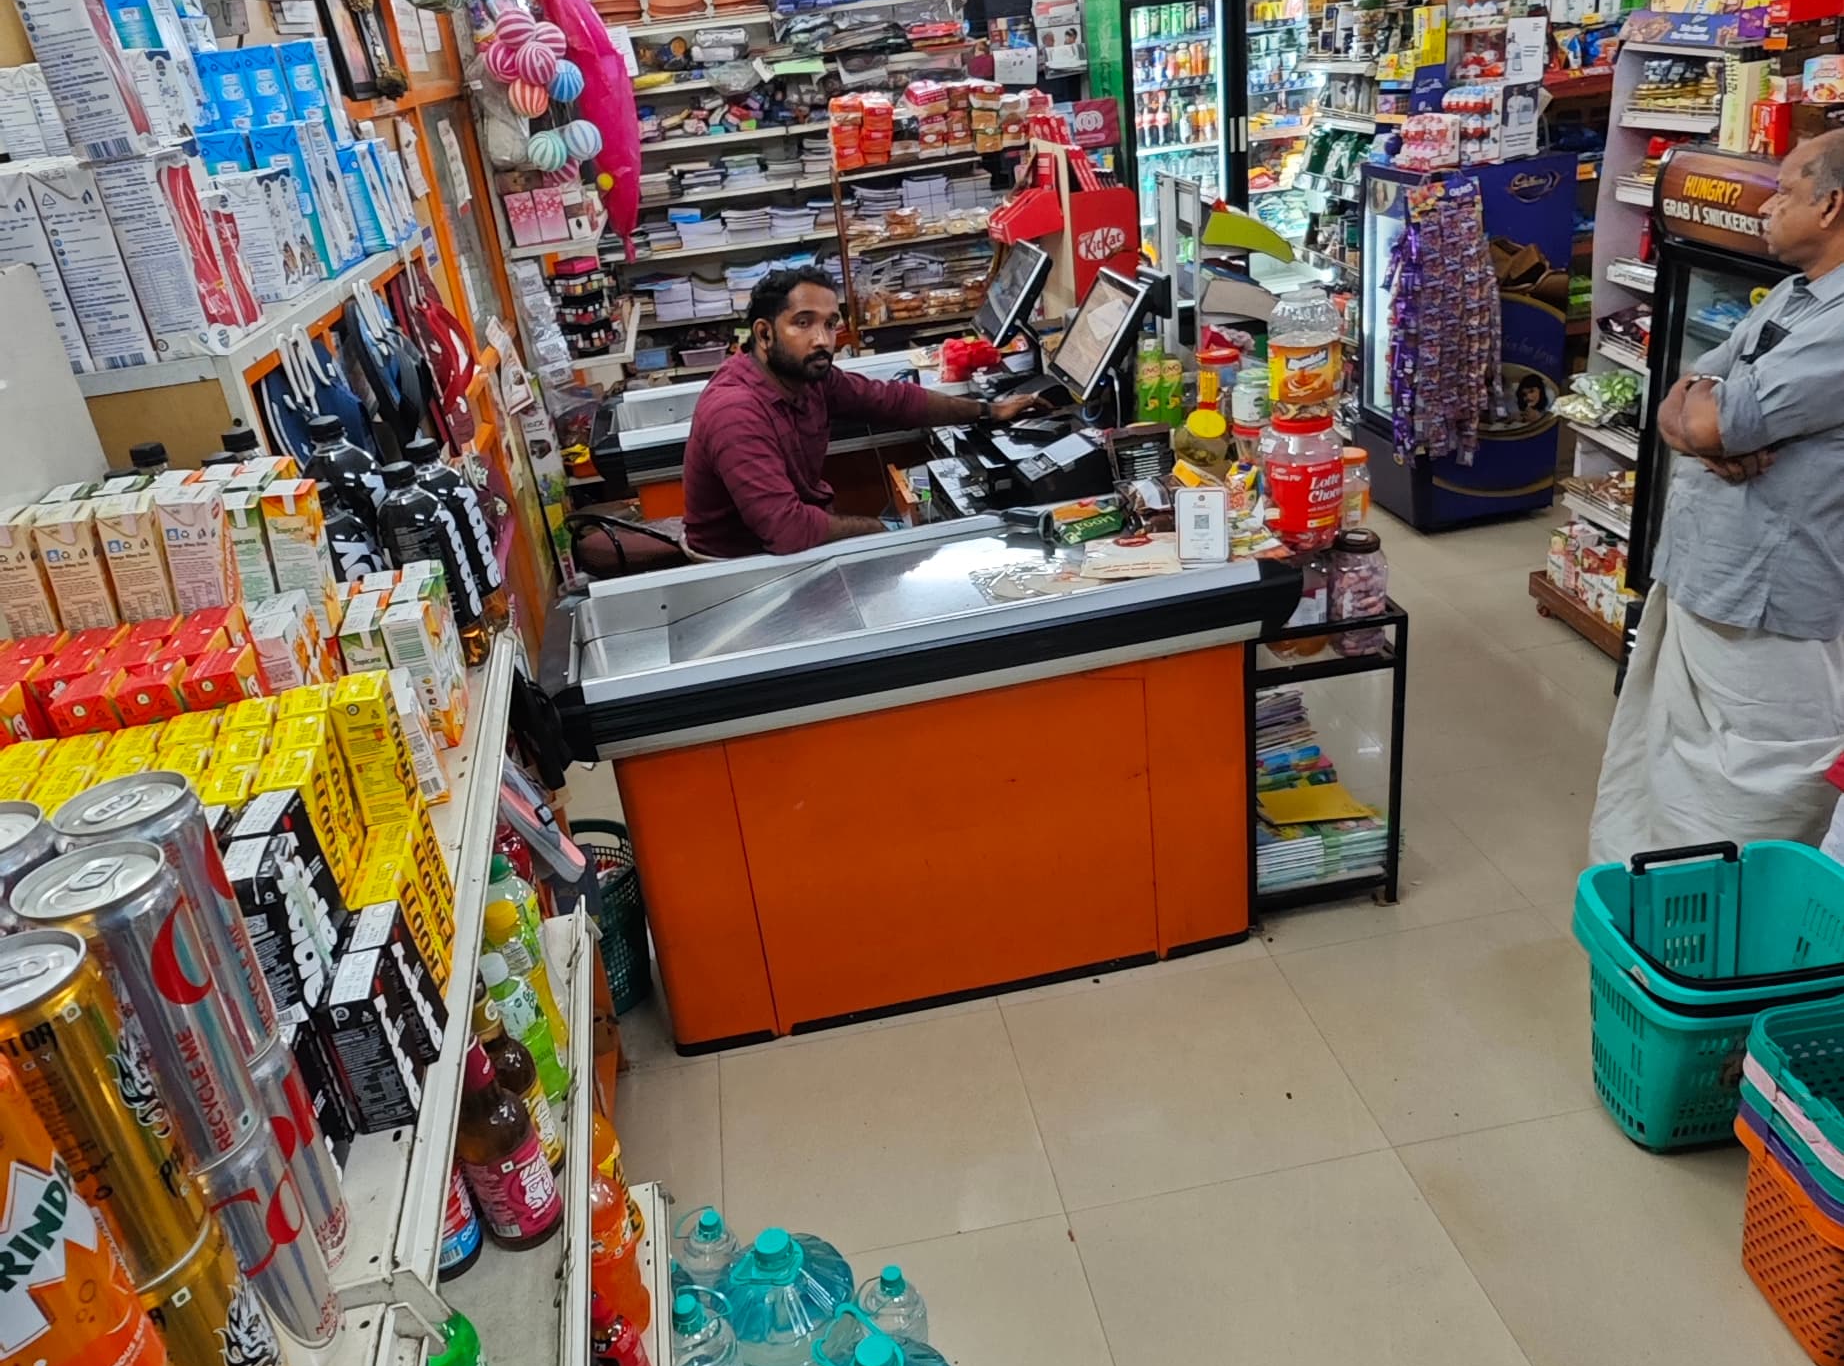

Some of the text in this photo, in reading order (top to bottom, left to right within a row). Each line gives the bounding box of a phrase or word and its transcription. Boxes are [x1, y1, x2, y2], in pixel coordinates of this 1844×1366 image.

[1683, 175, 1742, 206] HUNGRY?
[1663, 198, 1690, 220] GRAB
[1692, 204, 1701, 223] A
[1083, 229, 1124, 259] KitKat
[1310, 474, 1341, 491] Lotte
[402, 881, 448, 998] FROOTI
[175, 1026, 235, 1153] RECYCLE ME
[0, 1155, 73, 1293] RINDA
